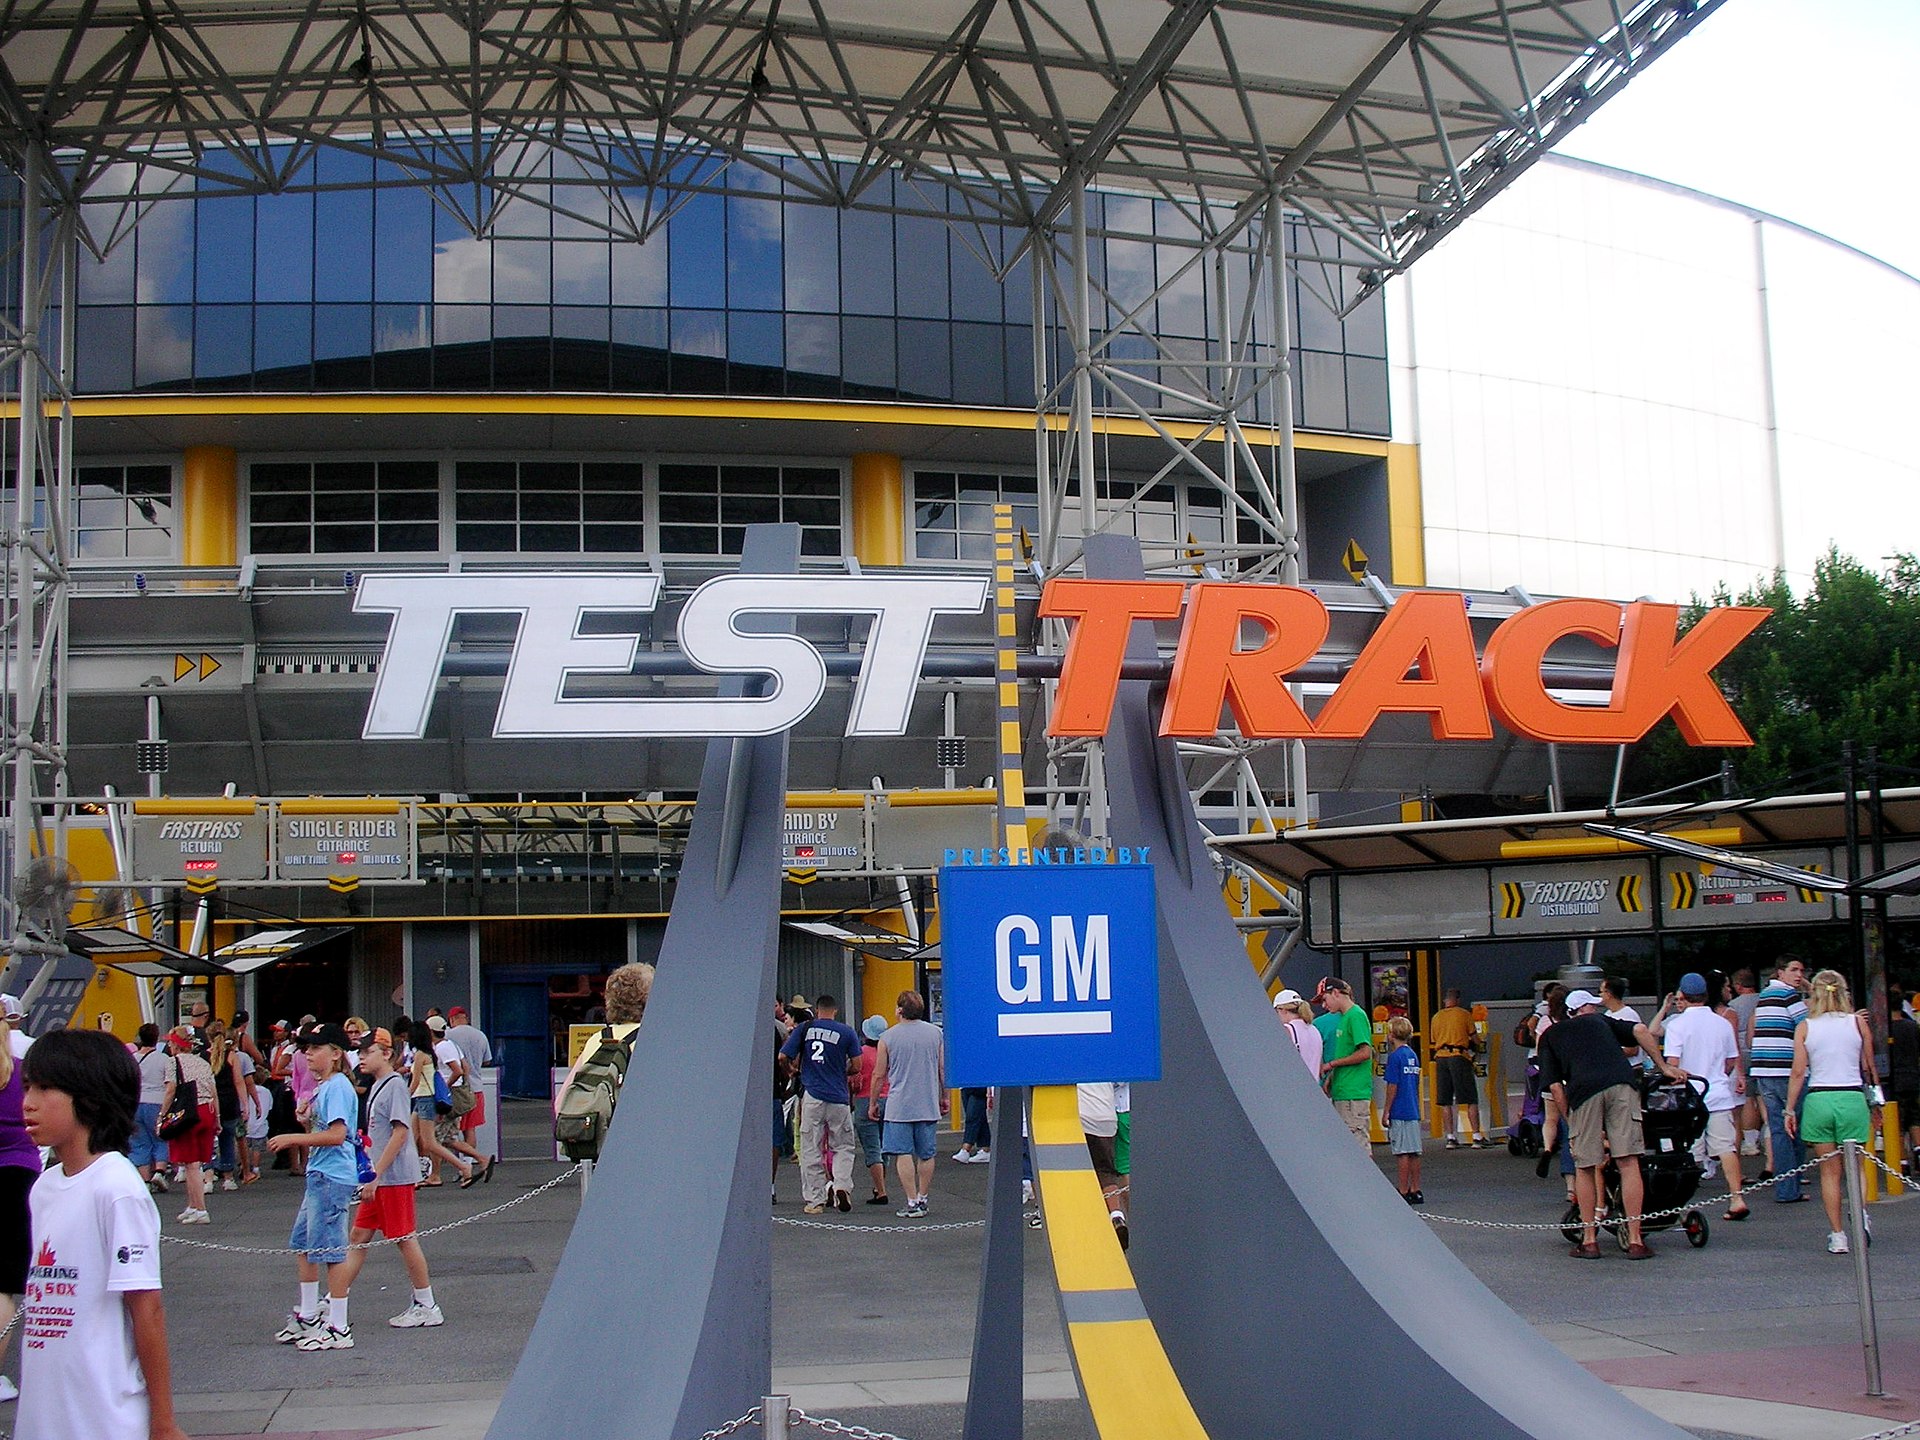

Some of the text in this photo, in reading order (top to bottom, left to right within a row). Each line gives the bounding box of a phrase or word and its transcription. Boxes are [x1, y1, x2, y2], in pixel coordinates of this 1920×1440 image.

[352, 573, 1774, 746] TEST TRACK
[160, 821, 243, 839] FASTPASS
[289, 820, 397, 838] SINGLE RIDER
[817, 813, 838, 830] BY
[316, 840, 370, 852] ENTRANCE
[782, 832, 827, 844] NTRANCE
[180, 841, 222, 853] RETURN
[820, 847, 858, 857] MINUTES
[362, 854, 401, 865] MINUTES
[944, 847, 1150, 867] PRESENTED BY
[1530, 880, 1610, 904] FASTPASS
[1541, 902, 1599, 916] DISTRIBUTION
[995, 914, 1111, 1005] GM
[811, 1041, 824, 1060] 2
[45, 1282, 77, 1296] SOX
